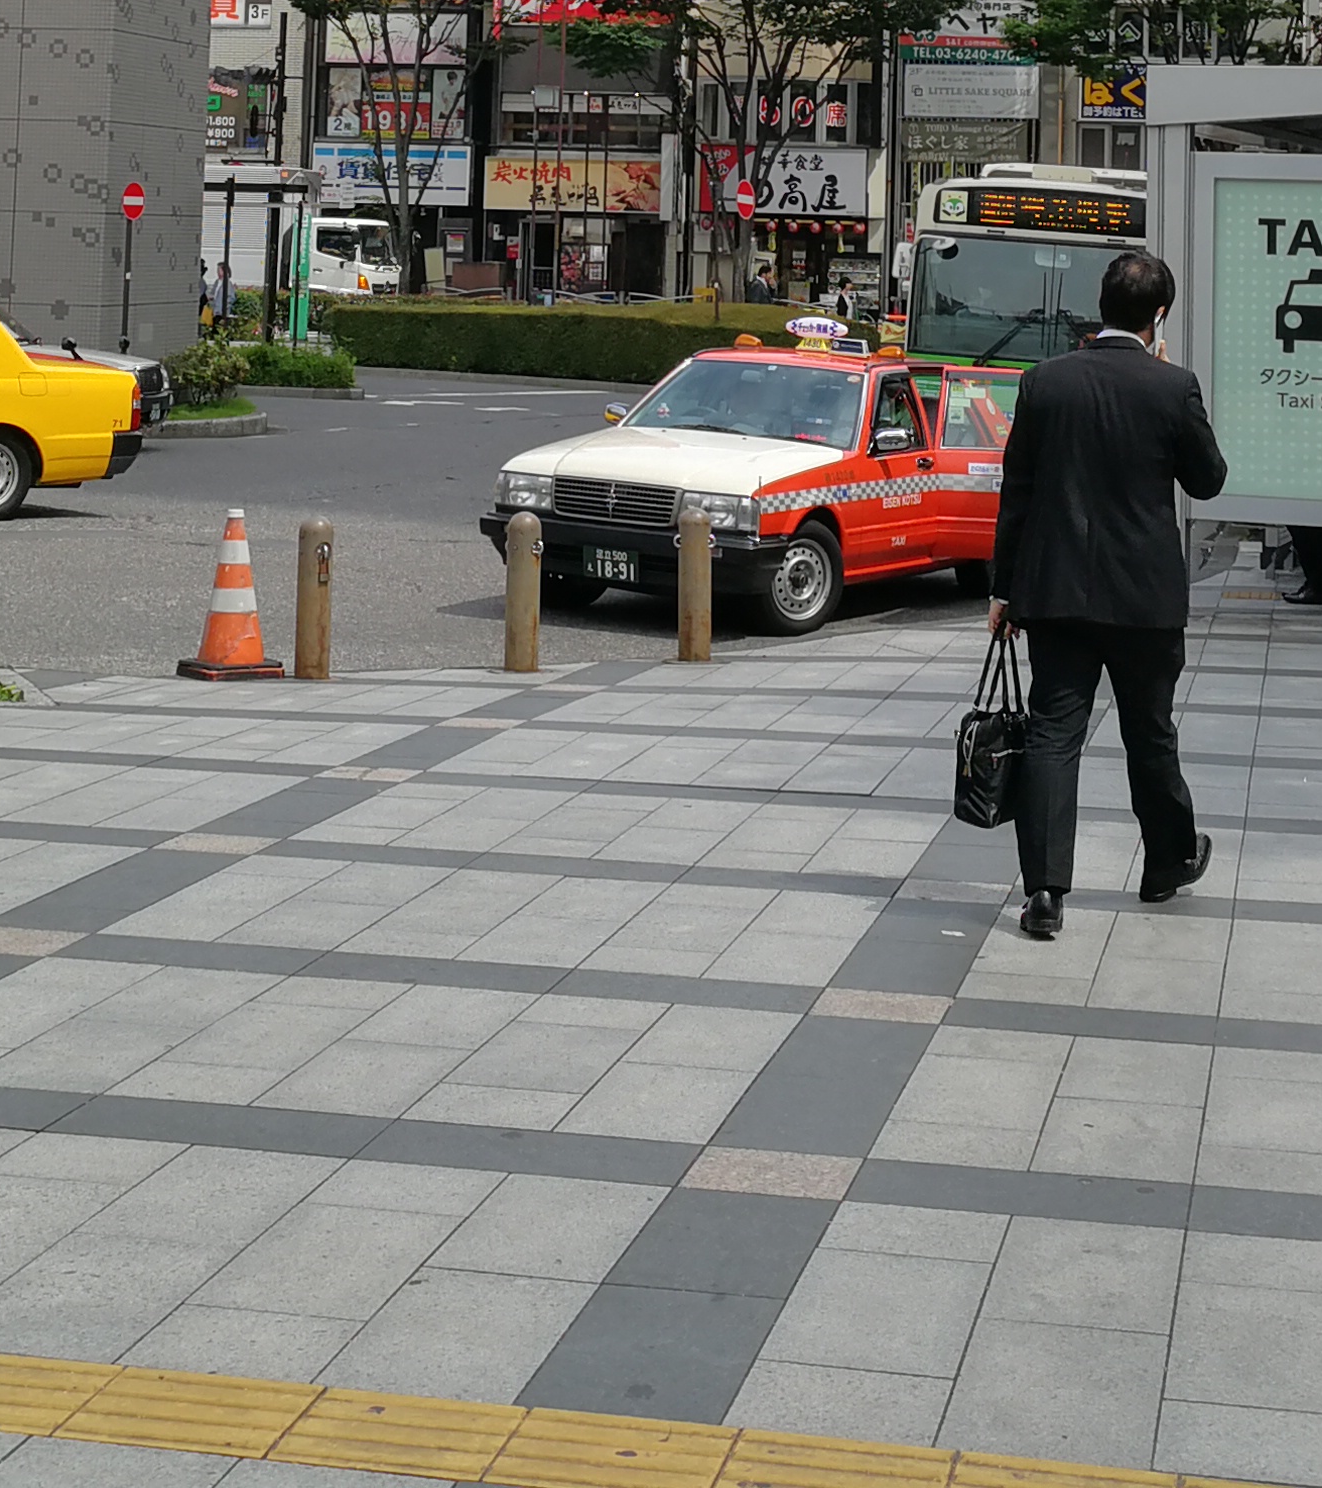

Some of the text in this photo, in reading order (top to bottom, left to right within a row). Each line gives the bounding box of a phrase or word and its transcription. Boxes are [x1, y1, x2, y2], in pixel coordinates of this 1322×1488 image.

[251, 5, 269, 19] 3F
[913, 47, 1021, 61] TEL.03-6240-470
[929, 87, 1032, 97] LITTLE SAKE SQUARE
[907, 134, 969, 150] ほぐし家
[1277, 392, 1315, 410] Taxi
[112, 419, 123, 429] 71
[902, 493, 922, 507] KOTSU
[597, 559, 635, 582] 18-91
